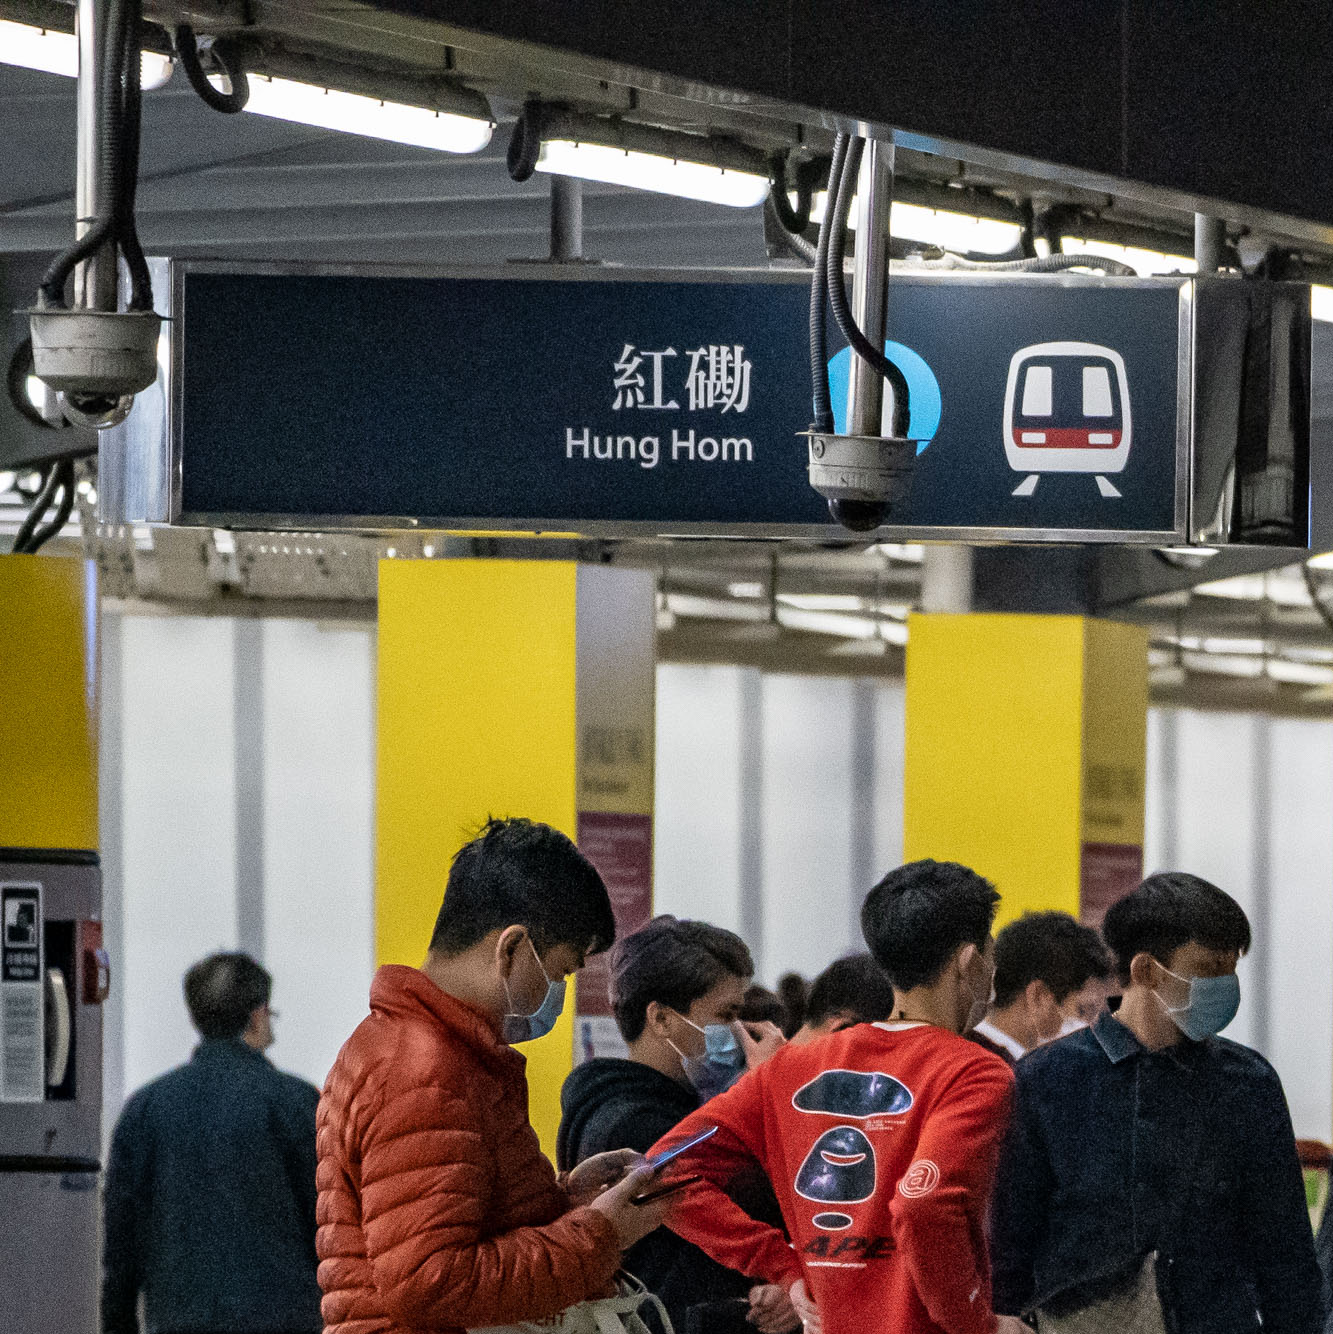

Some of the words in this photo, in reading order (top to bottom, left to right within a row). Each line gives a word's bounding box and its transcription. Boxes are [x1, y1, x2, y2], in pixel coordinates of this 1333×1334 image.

[610, 342, 753, 414] 紅磡
[566, 428, 660, 469] Hung
[671, 430, 753, 462] Hom
